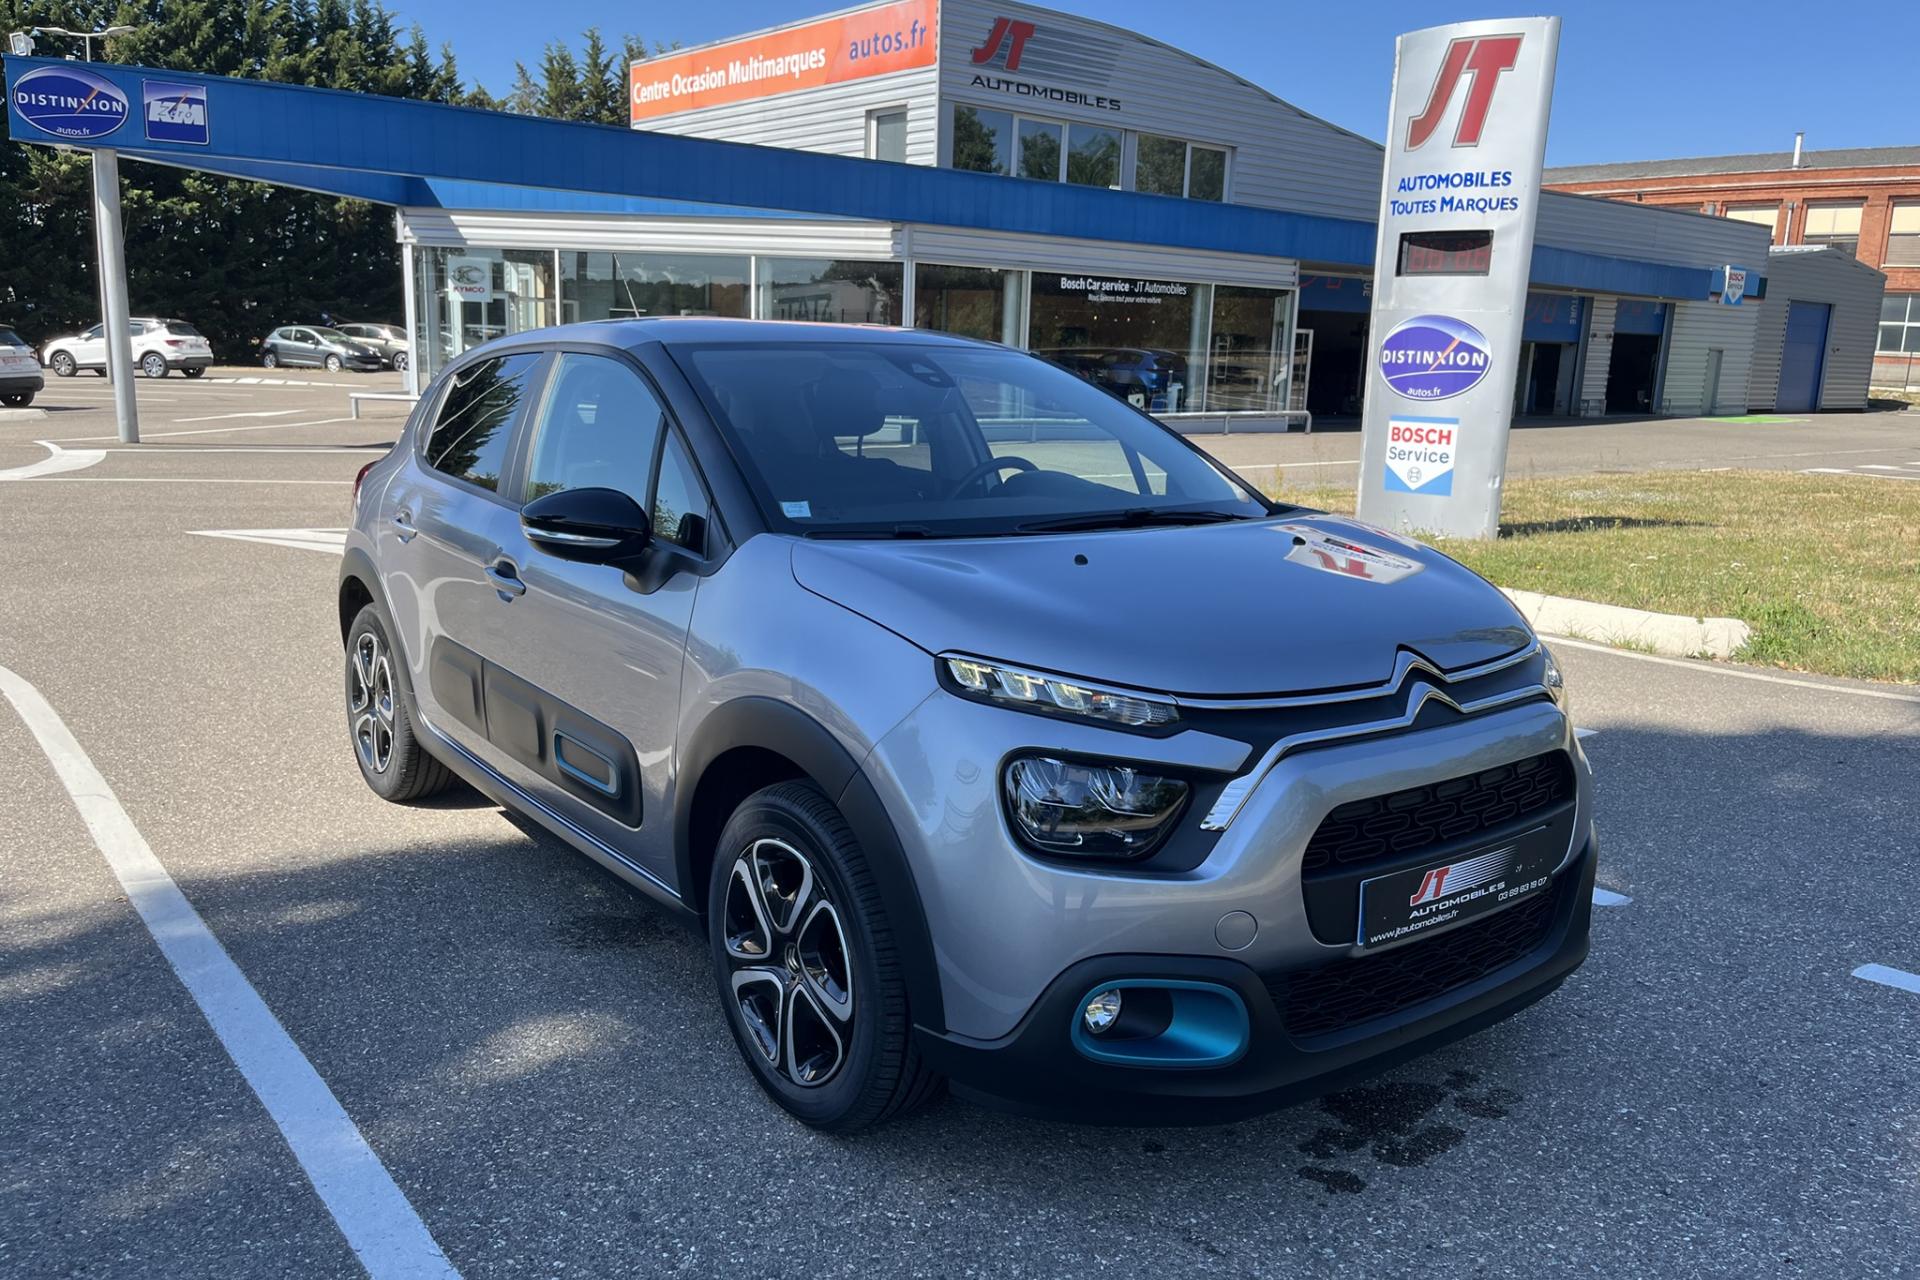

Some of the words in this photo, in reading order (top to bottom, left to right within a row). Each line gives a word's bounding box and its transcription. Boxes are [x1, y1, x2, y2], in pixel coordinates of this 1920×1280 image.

[971, 16, 1036, 73] JT
[633, 80, 670, 104] Centre
[672, 66, 727, 96] Occasion
[728, 48, 826, 85] Multimarques
[849, 19, 927, 60] autos.fr
[18, 91, 123, 113] DISTINXION
[971, 75, 1121, 111] AUTOMOBILES
[1404, 33, 1525, 152] JT
[56, 126, 90, 136] autos.fr
[1398, 171, 1512, 193] AUTOMOBILES
[1390, 199, 1436, 216] TOUTES
[1440, 196, 1519, 214] MARQUES
[1060, 277, 1085, 290] Bosch
[1086, 278, 1100, 291] Car
[1101, 280, 1129, 292] service
[1134, 281, 1145, 293] JT
[1145, 282, 1187, 295] Automobiles
[1382, 350, 1484, 367] DISTINXION
[1407, 387, 1441, 397] autos.fr
[1391, 427, 1452, 445] BOSCH
[1388, 446, 1450, 464] Service
[1410, 866, 1452, 906] JT
[1538, 876, 1548, 887] 07
[1409, 881, 1506, 920] AUTOMOBILES
